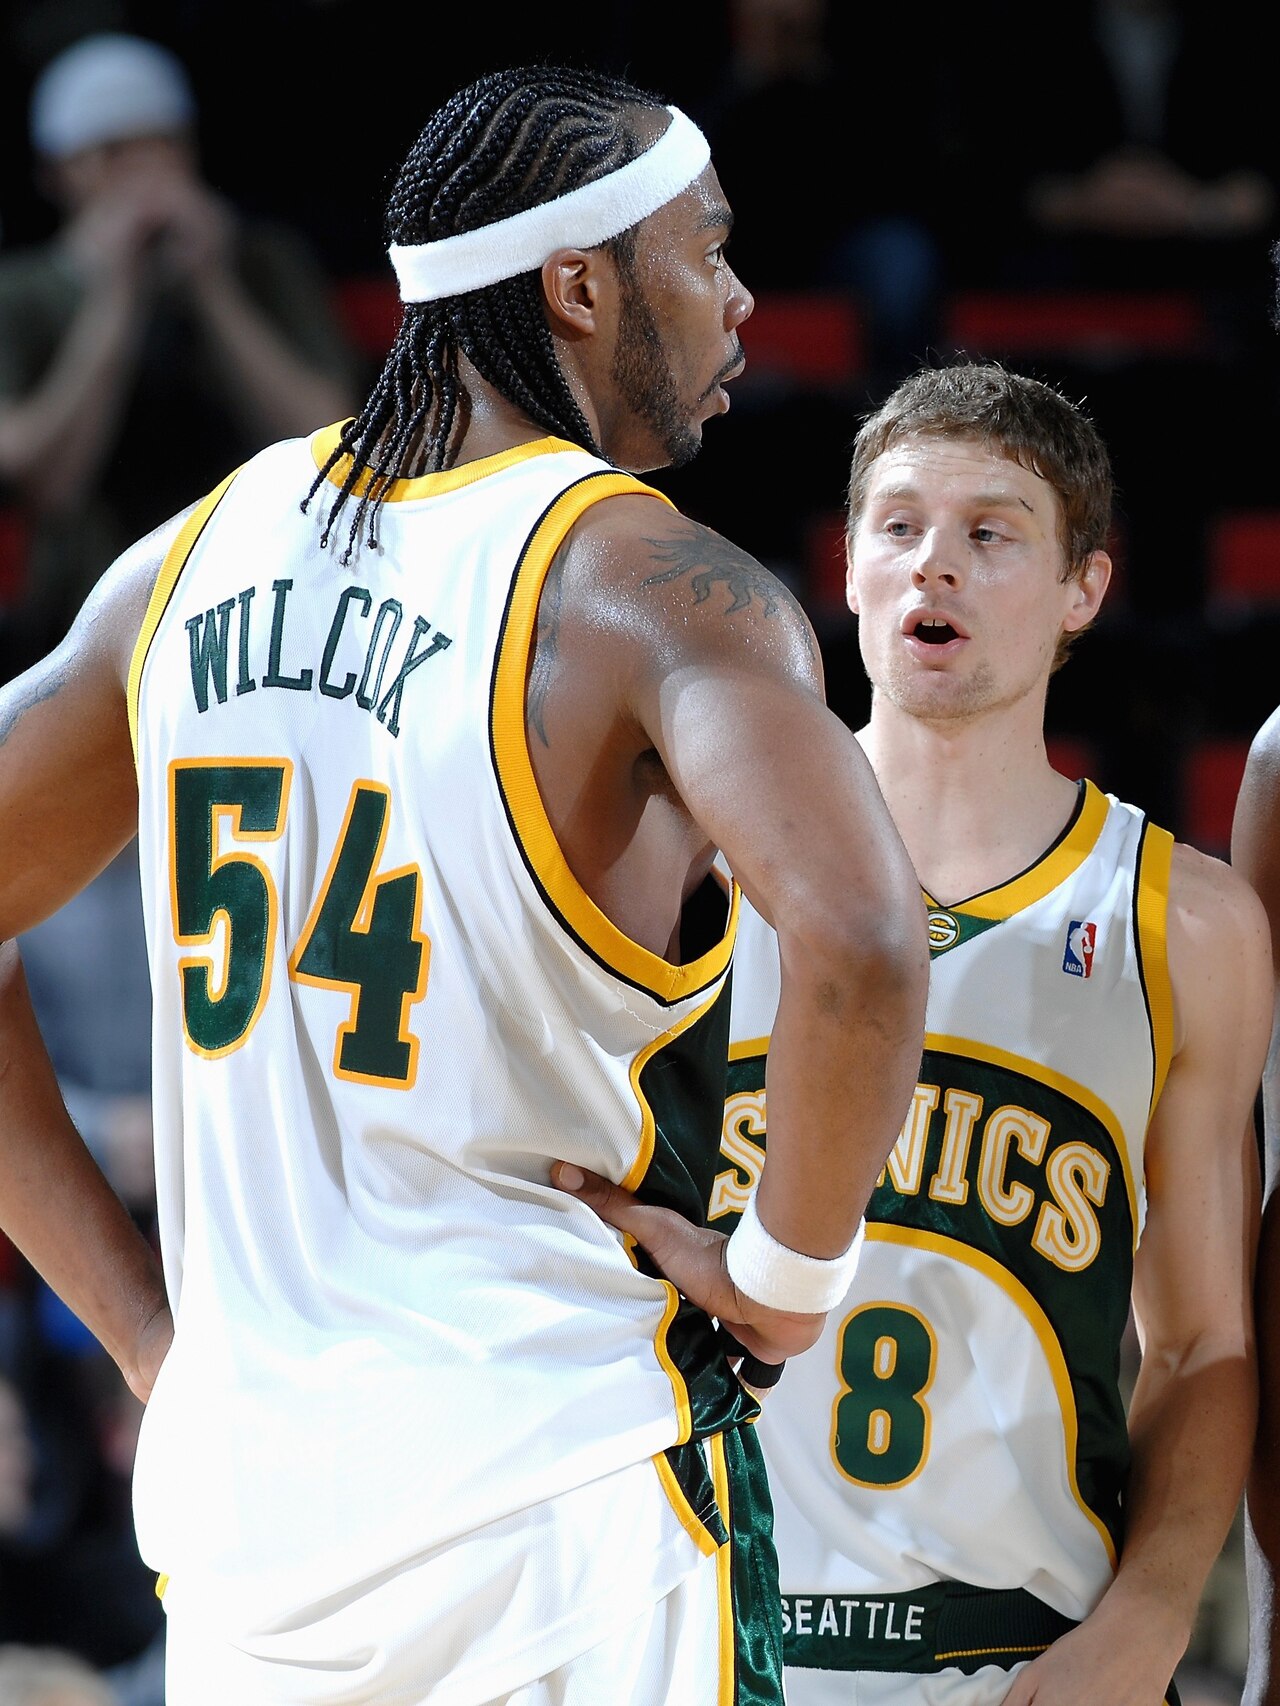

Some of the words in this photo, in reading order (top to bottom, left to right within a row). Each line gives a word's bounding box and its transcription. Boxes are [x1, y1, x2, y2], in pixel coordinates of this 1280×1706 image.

[185, 579, 453, 738] WILCOX
[168, 756, 431, 1090] 54
[1065, 962, 1082, 974] NBA
[707, 1083, 1110, 1272] SNICS
[829, 1300, 938, 1490] 8
[780, 1597, 926, 1641] SEATTLE
